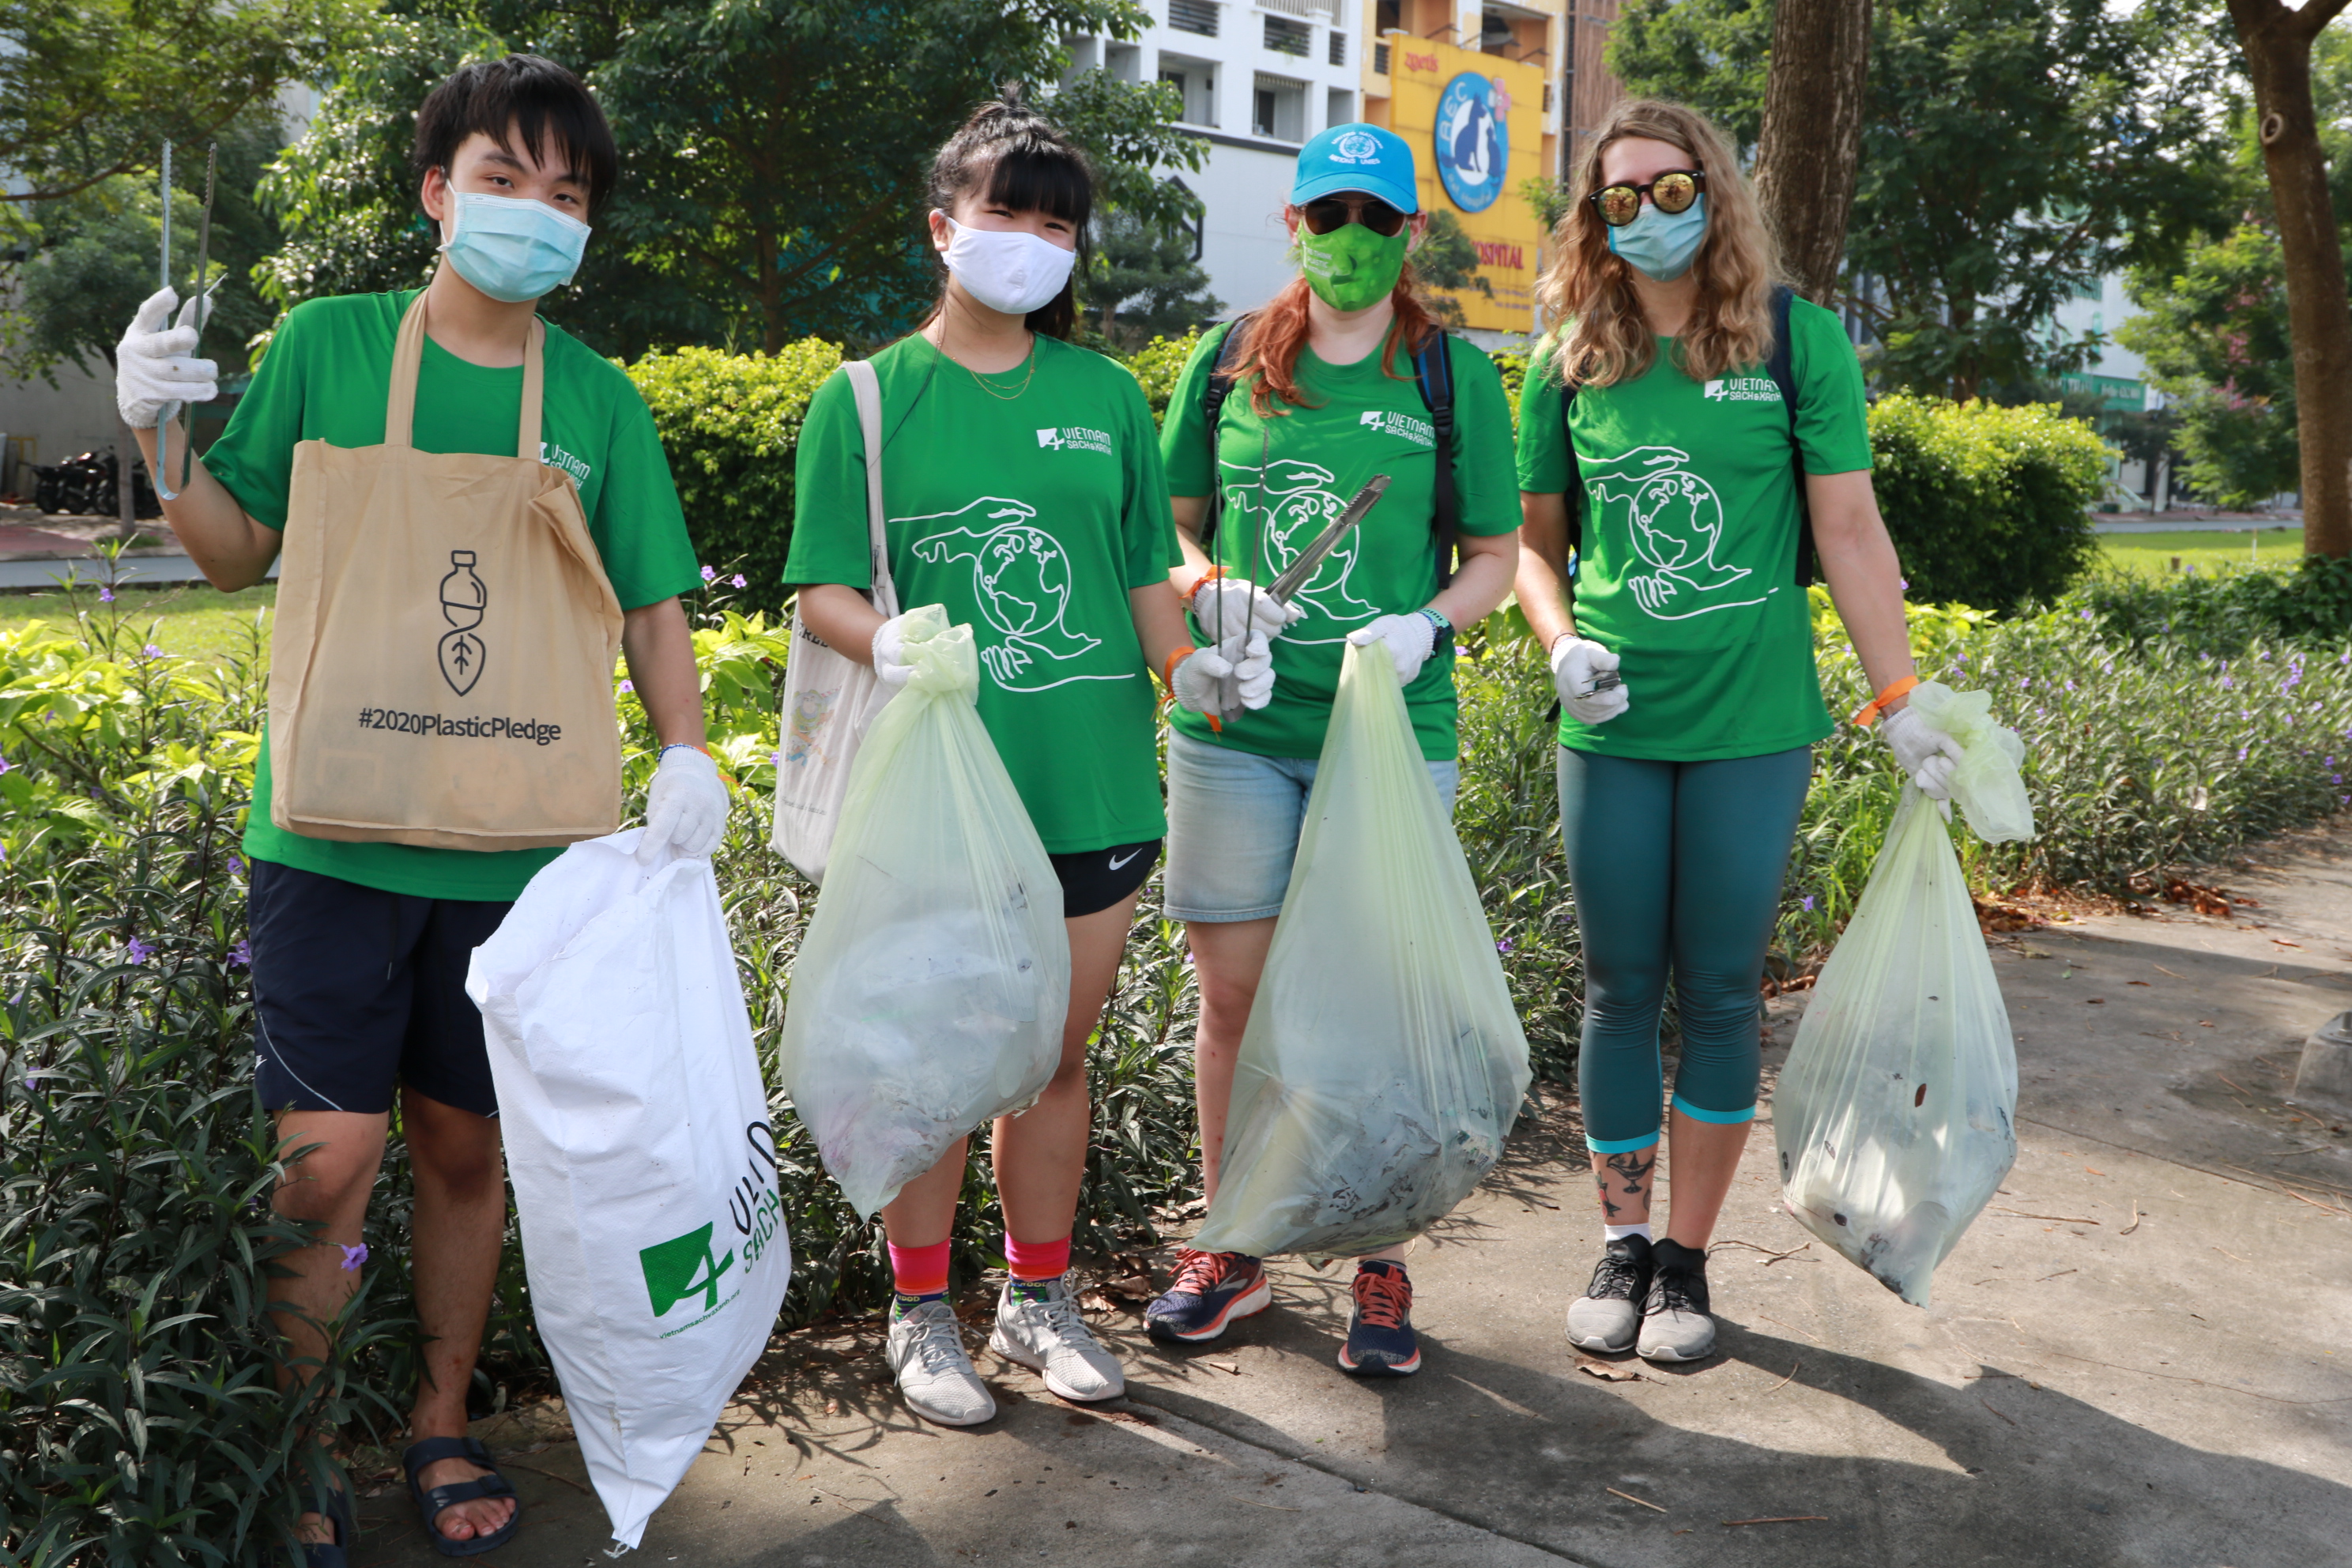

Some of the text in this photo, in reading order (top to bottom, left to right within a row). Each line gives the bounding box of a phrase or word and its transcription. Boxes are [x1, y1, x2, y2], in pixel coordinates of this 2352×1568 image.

[1062, 427, 1111, 446] VIETNAM
[1387, 411, 1435, 439] VIETNAM
[358, 707, 562, 746] #2020PlasticPledge
[659, 1289, 740, 1339] vietnamsachvaxanh.org
